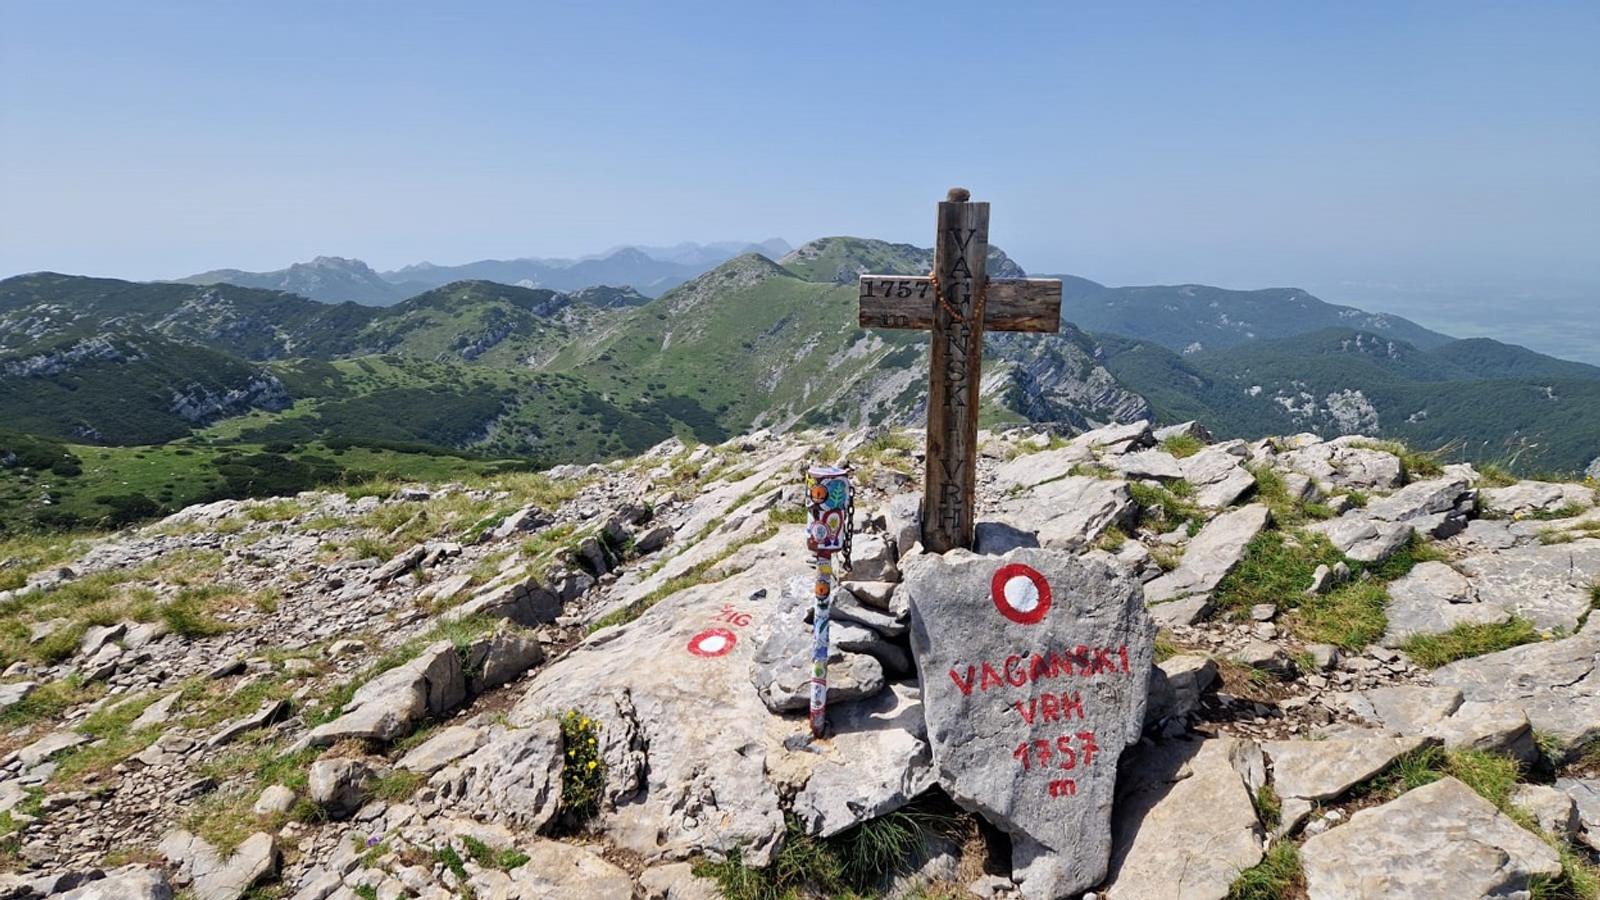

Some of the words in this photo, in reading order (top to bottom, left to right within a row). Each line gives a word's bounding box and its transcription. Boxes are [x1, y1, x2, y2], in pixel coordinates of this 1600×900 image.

[861, 281, 929, 298] 1757
[938, 459, 963, 528] VRH
[949, 645, 1130, 696] VAGANSKI
[1015, 690, 1085, 726] VRH
[1013, 731, 1099, 772] 1757
[1049, 779, 1076, 799] m
